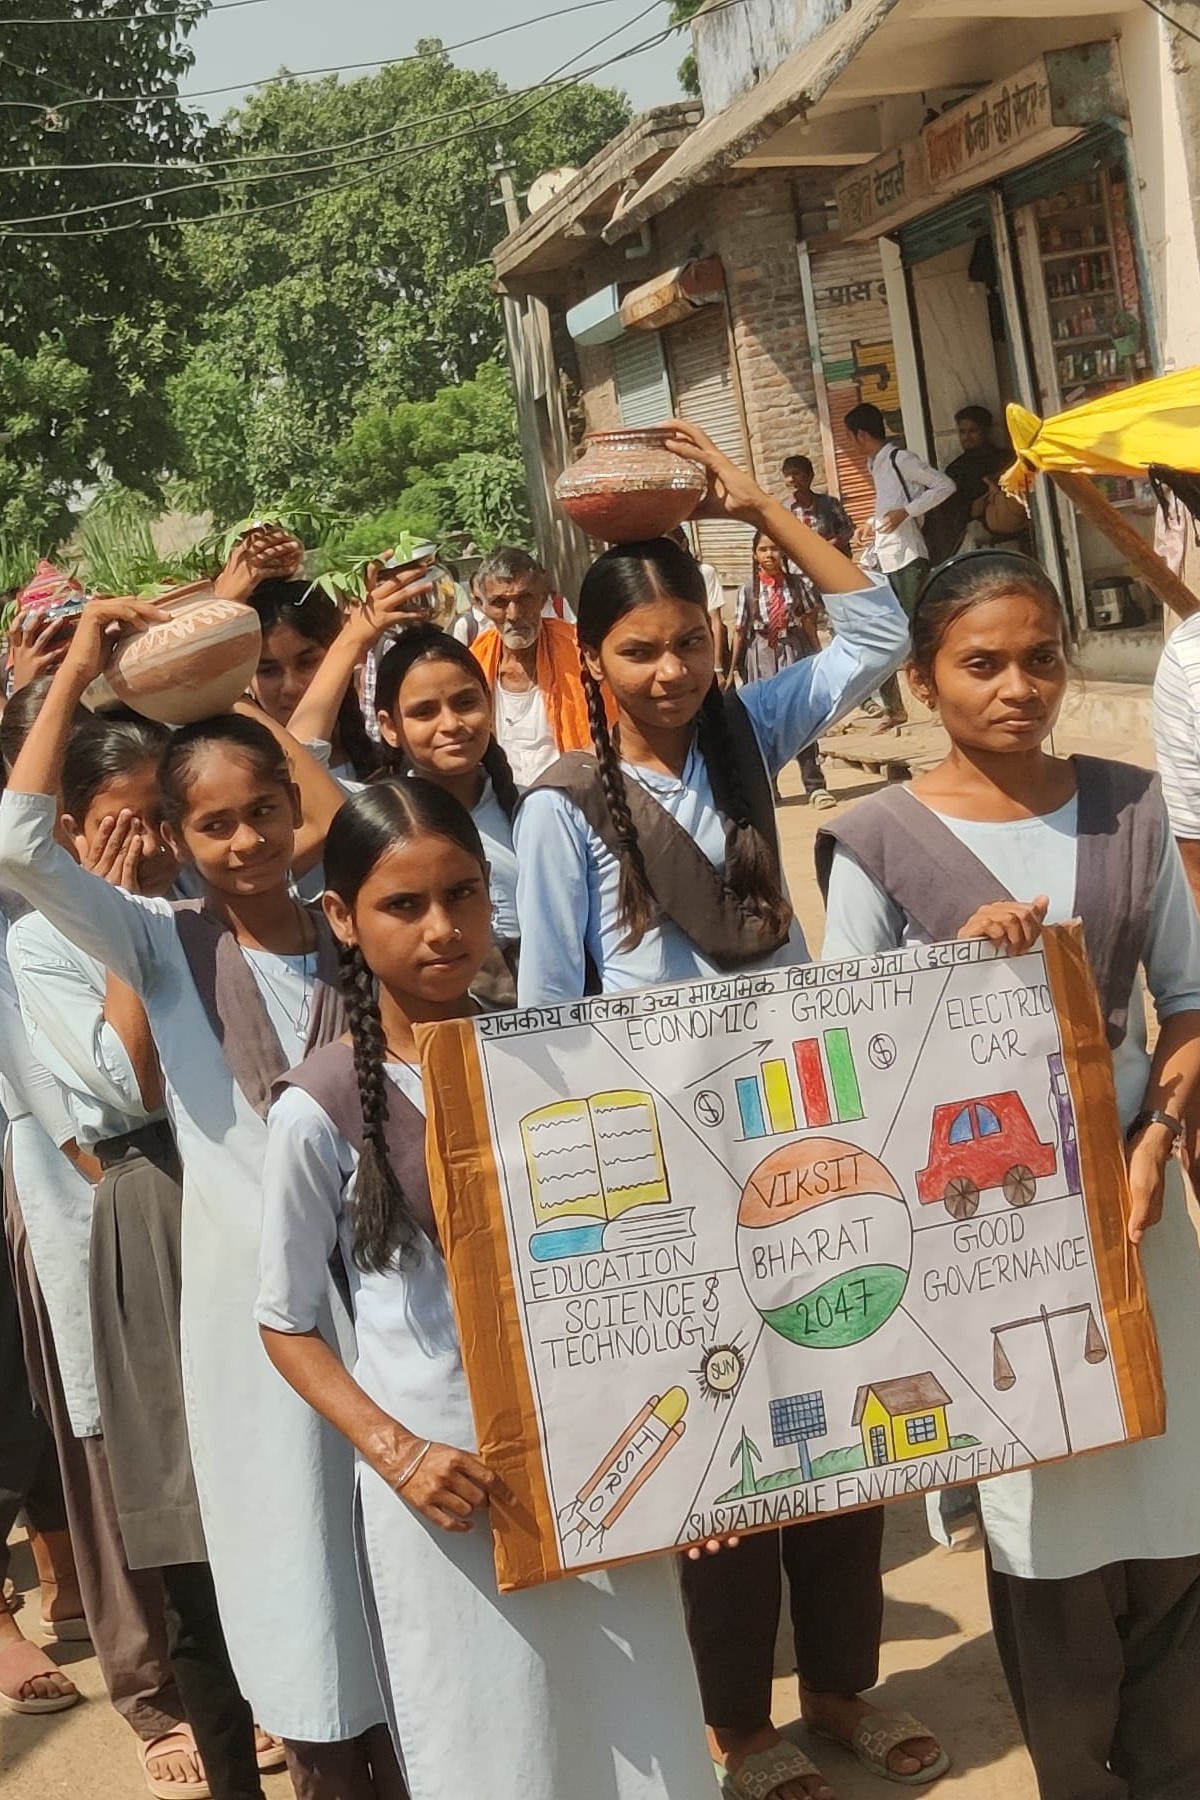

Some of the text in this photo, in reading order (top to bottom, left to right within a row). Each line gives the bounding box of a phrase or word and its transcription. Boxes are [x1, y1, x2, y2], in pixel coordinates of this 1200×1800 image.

[478, 1007, 566, 1036] राजकीय
[569, 996, 640, 1023] बालिका
[643, 987, 685, 1012] उच्च
[688, 971, 781, 1003] माध्यमिक
[785, 957, 867, 990] विद्यालय
[626, 1001, 758, 1050] ECONOMIC
[791, 975, 914, 1023] GROWTH
[946, 984, 1053, 1030] ELECTRIC
[970, 1029, 1027, 1065] CAR
[750, 1152, 863, 1209] VIKSIT
[751, 1216, 874, 1280] BHARAT
[953, 1212, 1026, 1253] GOOD
[530, 1241, 696, 1299] EDUCATION
[923, 1236, 1089, 1302] GOVERNANCE
[565, 1282, 696, 1334] SCIENCE
[796, 1278, 874, 1334] 2047
[540, 1312, 720, 1369] TECHNOLOGY
[710, 1356, 735, 1380] SUN
[687, 1441, 1019, 1544] SUSTAINABLE ENVIRONMENT
